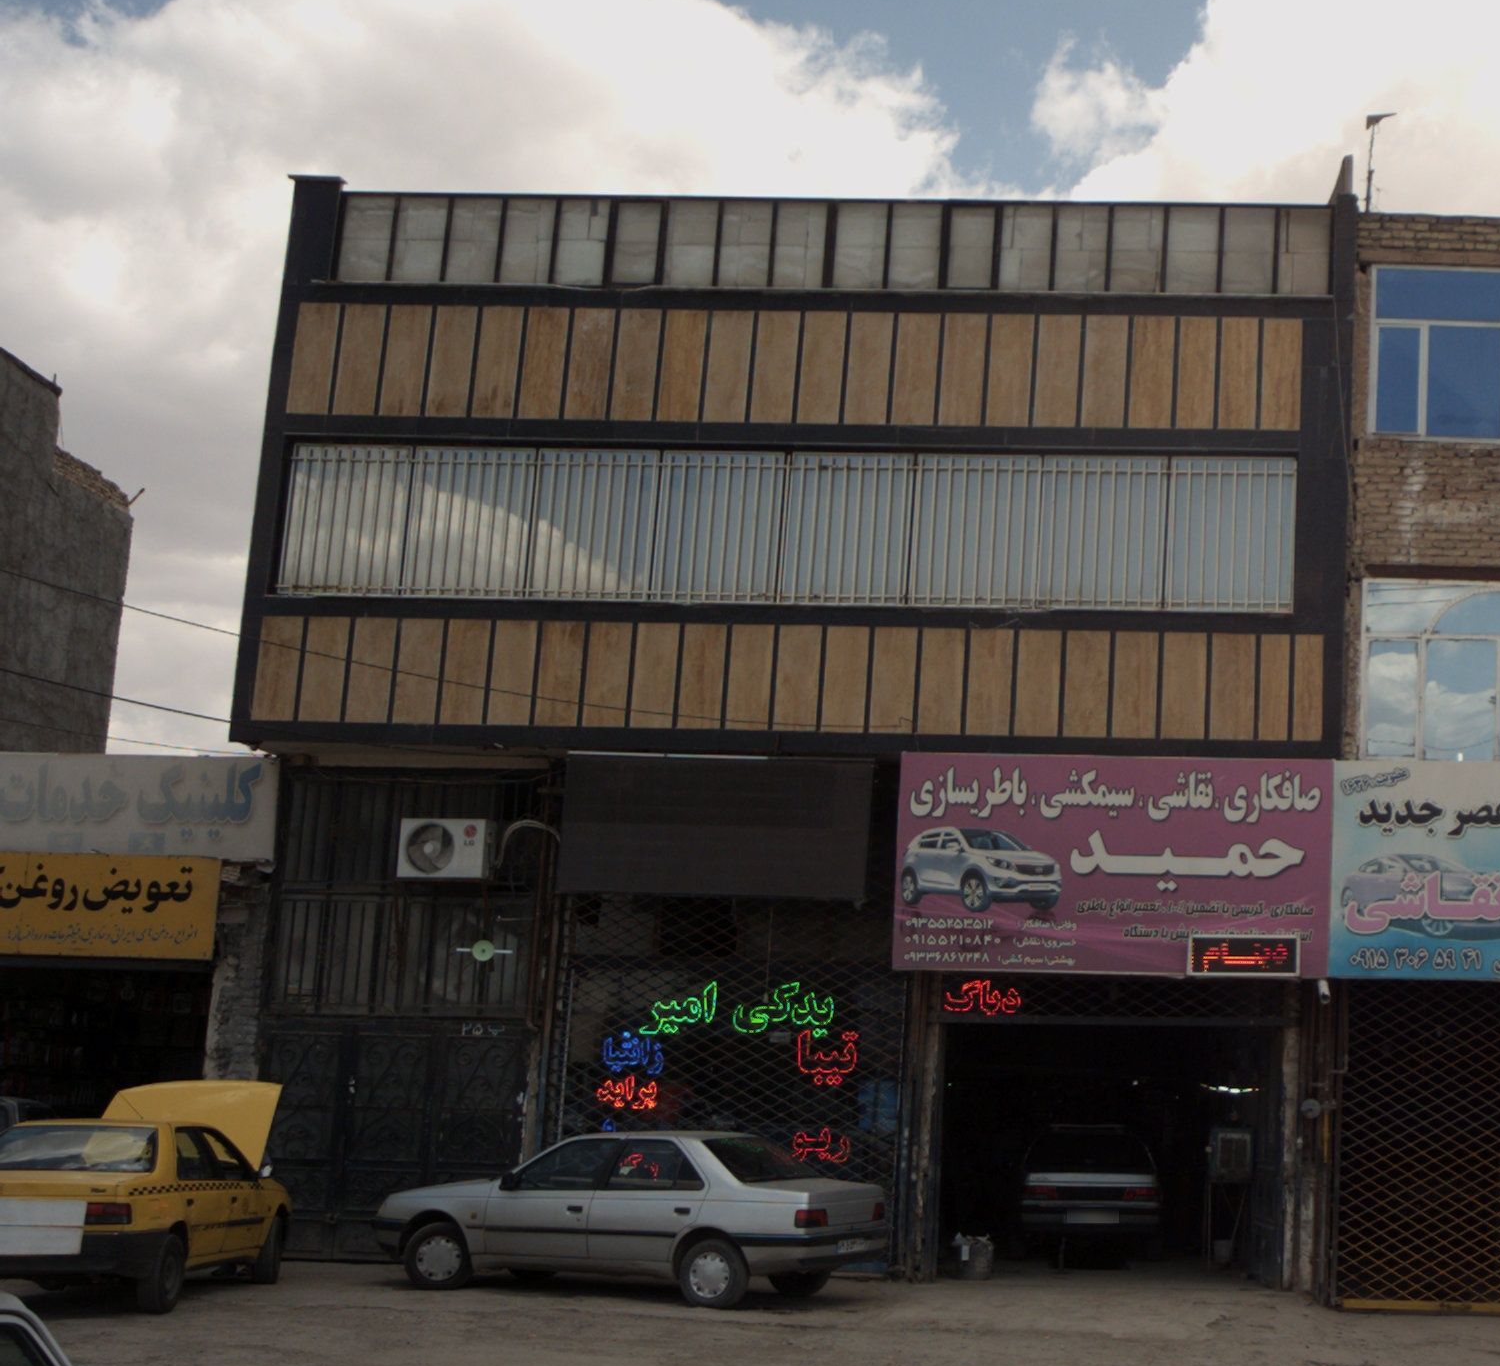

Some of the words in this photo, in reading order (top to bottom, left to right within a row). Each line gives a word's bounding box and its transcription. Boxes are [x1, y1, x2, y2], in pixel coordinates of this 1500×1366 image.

[137, 762, 262, 842] کلینیک
[909, 765, 1027, 819] باطریسازی
[1358, 795, 1445, 837] جدید
[1070, 829, 1306, 892] حمید
[0, 863, 79, 912] روغن
[83, 865, 194, 915] تعویض
[1350, 948, 1389, 970] ۰۹۱۵
[1393, 948, 1429, 970] ۳۰۶
[1432, 948, 1457, 970] ۵۹
[1460, 948, 1482, 970] ۴۱
[639, 980, 718, 1035] امیر
[733, 982, 835, 1037] یدکی
[602, 1031, 664, 1076] زانتیا
[797, 1030, 859, 1085] تیبا
[595, 1075, 658, 1109] پراید
[791, 1126, 851, 1163] ریو
